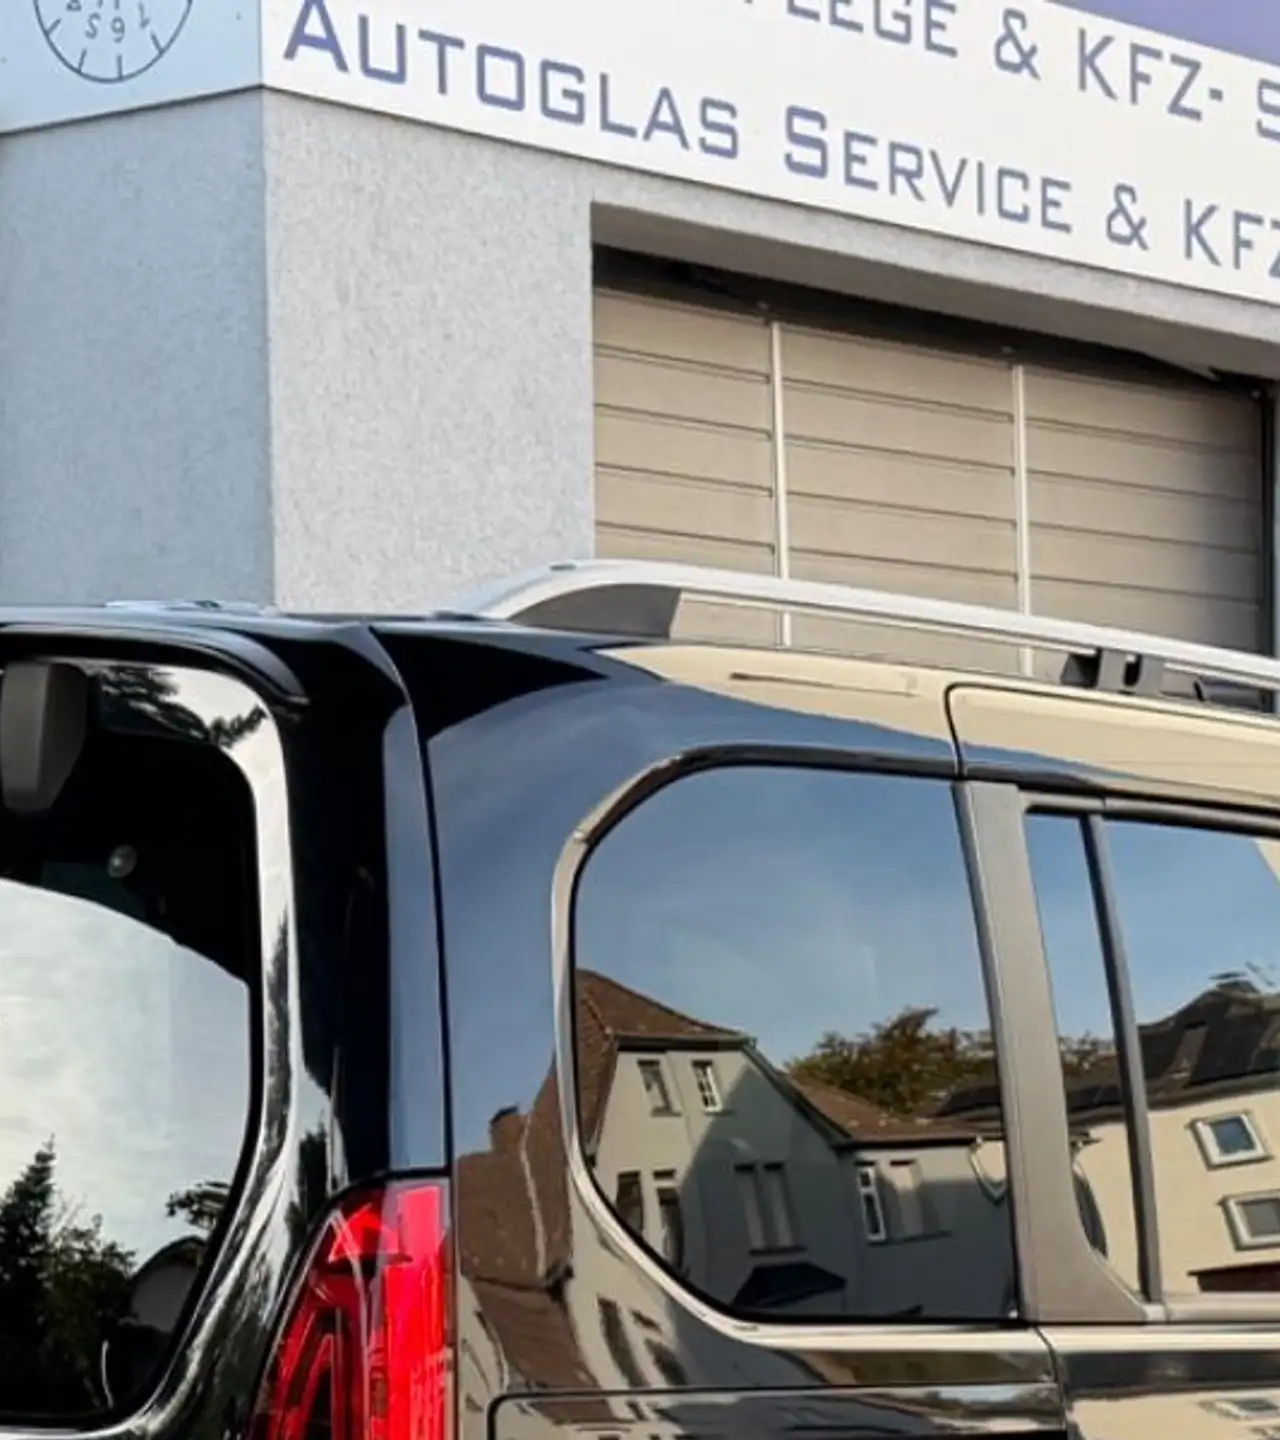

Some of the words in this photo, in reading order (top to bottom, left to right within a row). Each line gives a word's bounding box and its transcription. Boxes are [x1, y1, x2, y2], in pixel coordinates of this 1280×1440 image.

[283, 0, 738, 160] AUTOGLAS
[784, 103, 1073, 235] SERVICE
[1105, 181, 1150, 252] &
[993, 7, 1041, 82] &
